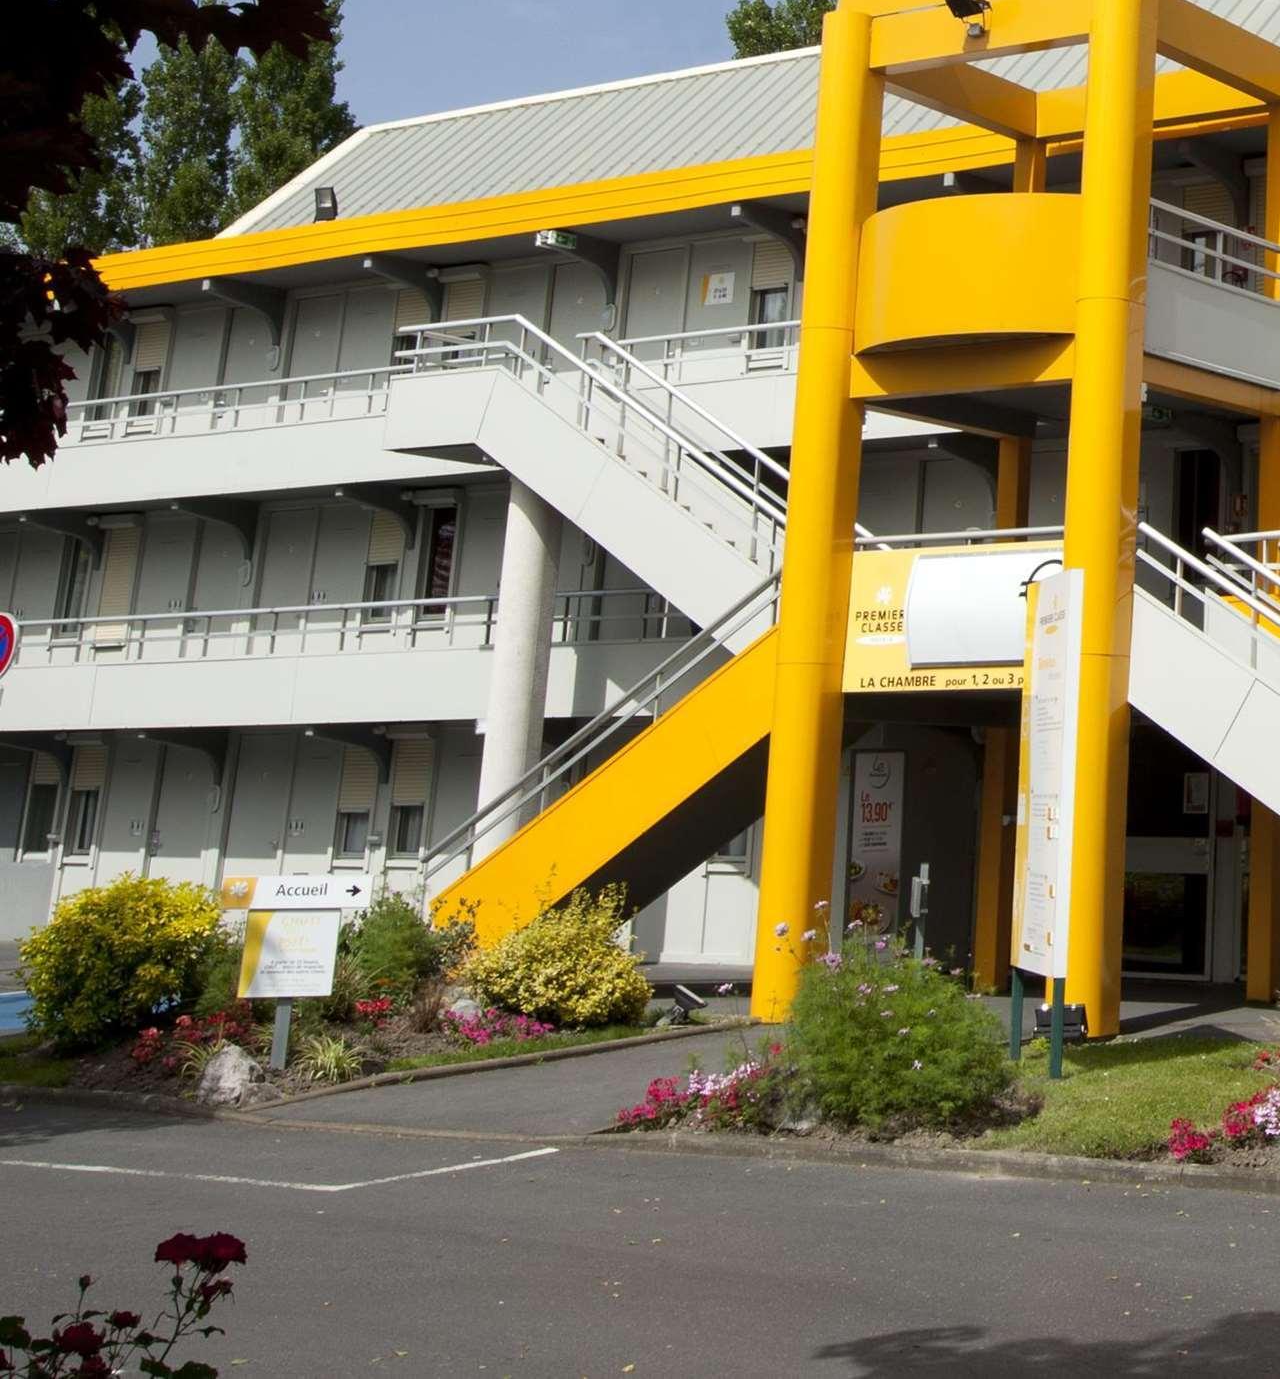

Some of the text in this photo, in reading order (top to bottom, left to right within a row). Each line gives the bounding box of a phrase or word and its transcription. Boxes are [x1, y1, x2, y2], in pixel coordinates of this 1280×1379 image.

[855, 609, 904, 621] PREMIER
[861, 621, 903, 633] CLASSE
[860, 677, 875, 688] LA
[879, 675, 937, 688] CHAMBRE
[945, 678, 967, 689] pour
[982, 673, 989, 685] 2
[992, 677, 1004, 685] ou
[1007, 673, 1015, 685] 3
[275, 882, 328, 896] Accueil
